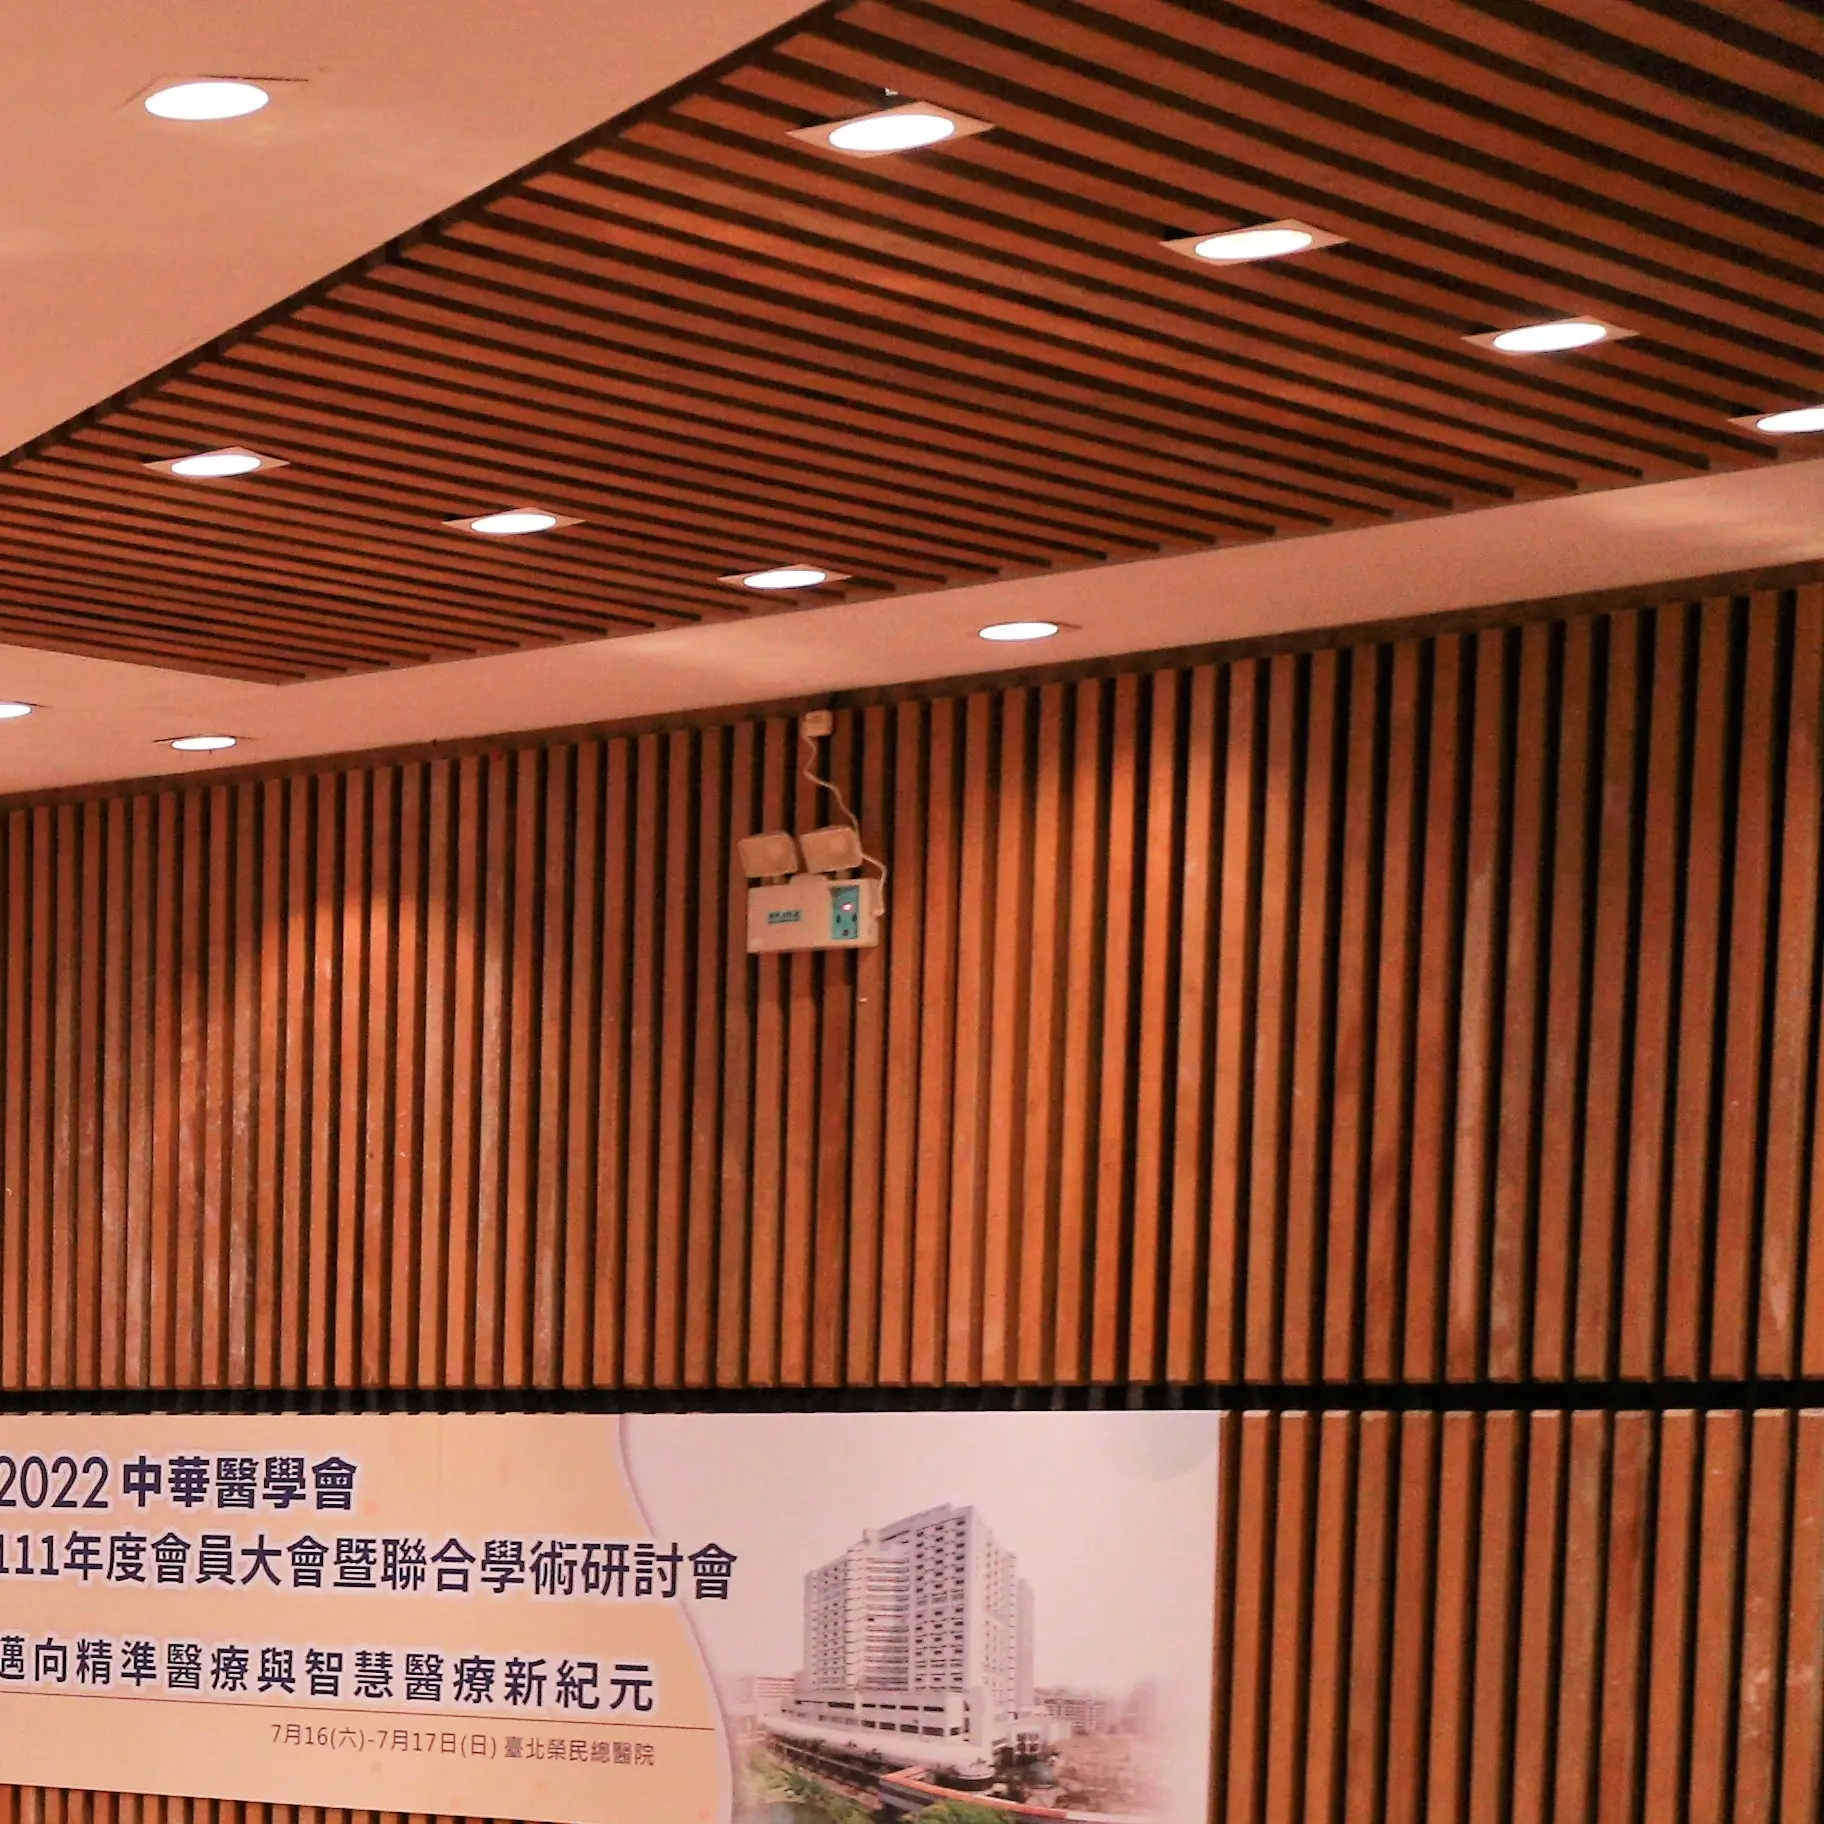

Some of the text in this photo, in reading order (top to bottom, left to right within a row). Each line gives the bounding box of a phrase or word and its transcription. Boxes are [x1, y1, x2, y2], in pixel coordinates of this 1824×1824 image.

[122, 1455, 357, 1510] 中華醫學會
[503, 1736, 656, 1766] 臺北榮民總醫院
